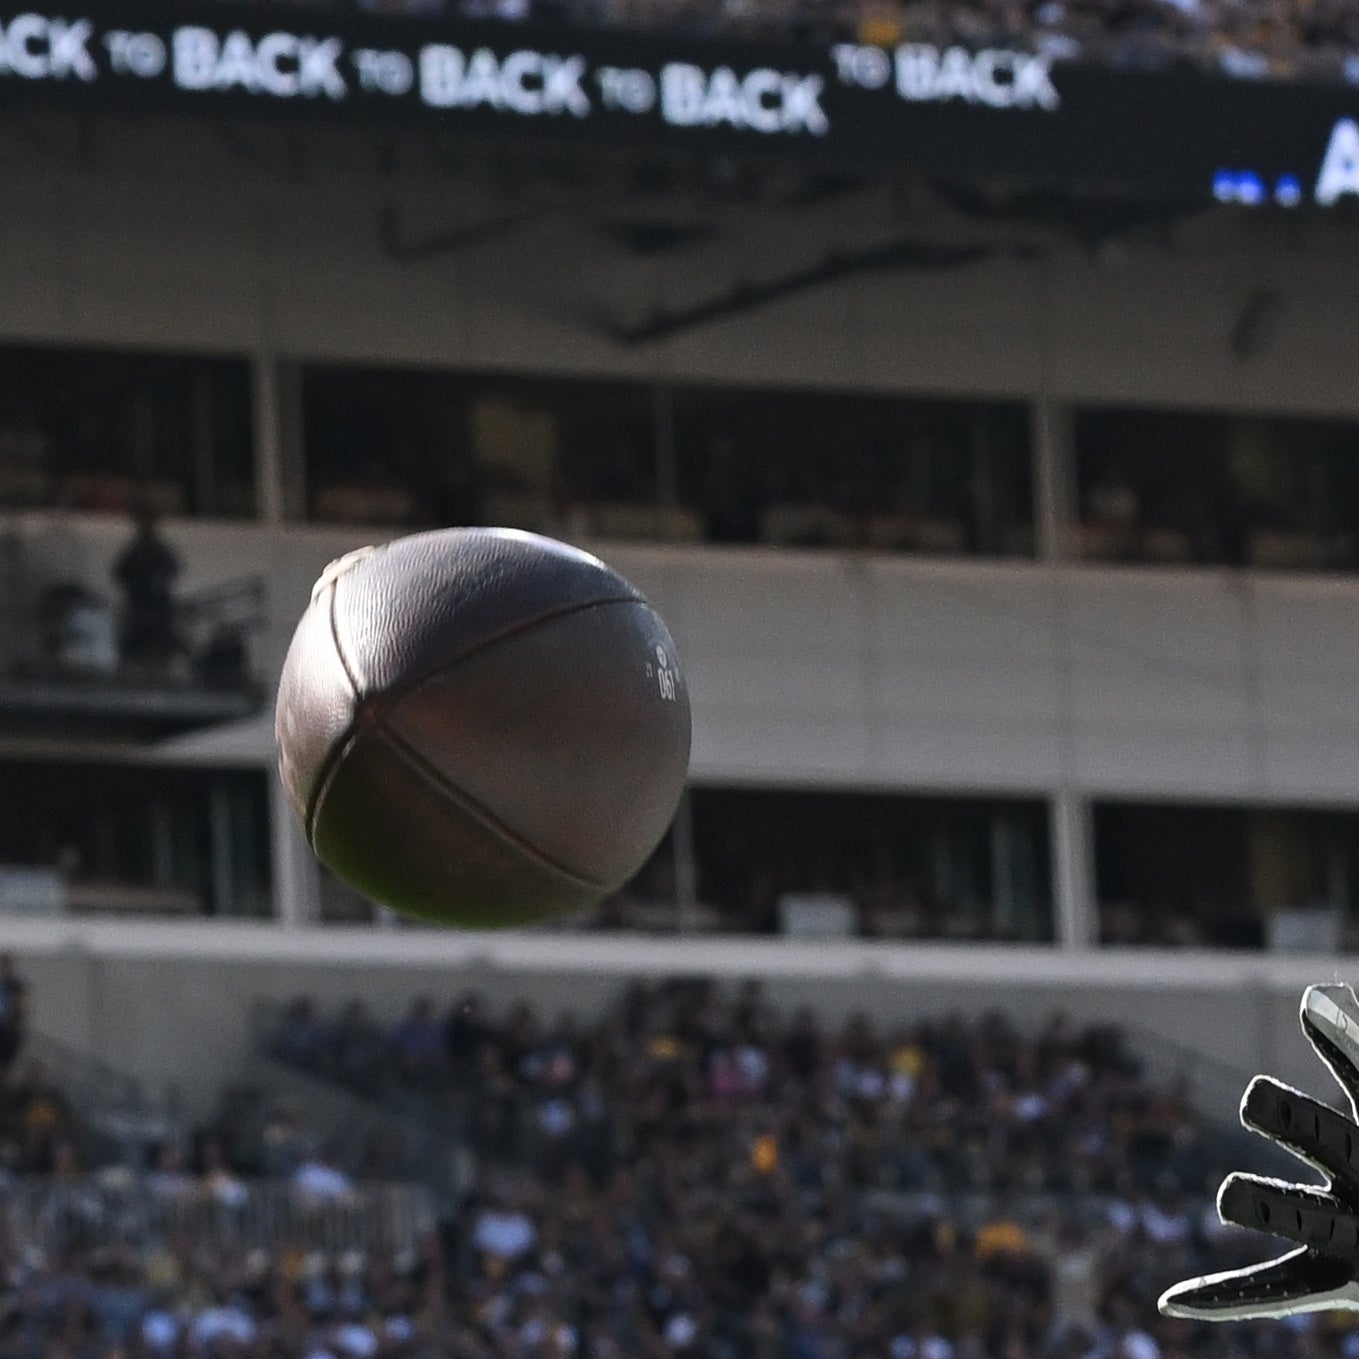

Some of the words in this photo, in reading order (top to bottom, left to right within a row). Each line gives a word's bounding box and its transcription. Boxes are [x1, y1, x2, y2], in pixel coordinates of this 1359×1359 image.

[0, 13, 95, 80] CK
[105, 31, 166, 76] TO
[172, 26, 345, 98] BACK
[354, 49, 413, 94] TO
[419, 44, 589, 115] BACK
[597, 67, 656, 113] TO
[660, 63, 828, 132] BACK
[833, 40, 891, 88] TO
[895, 42, 1062, 106] BACK
